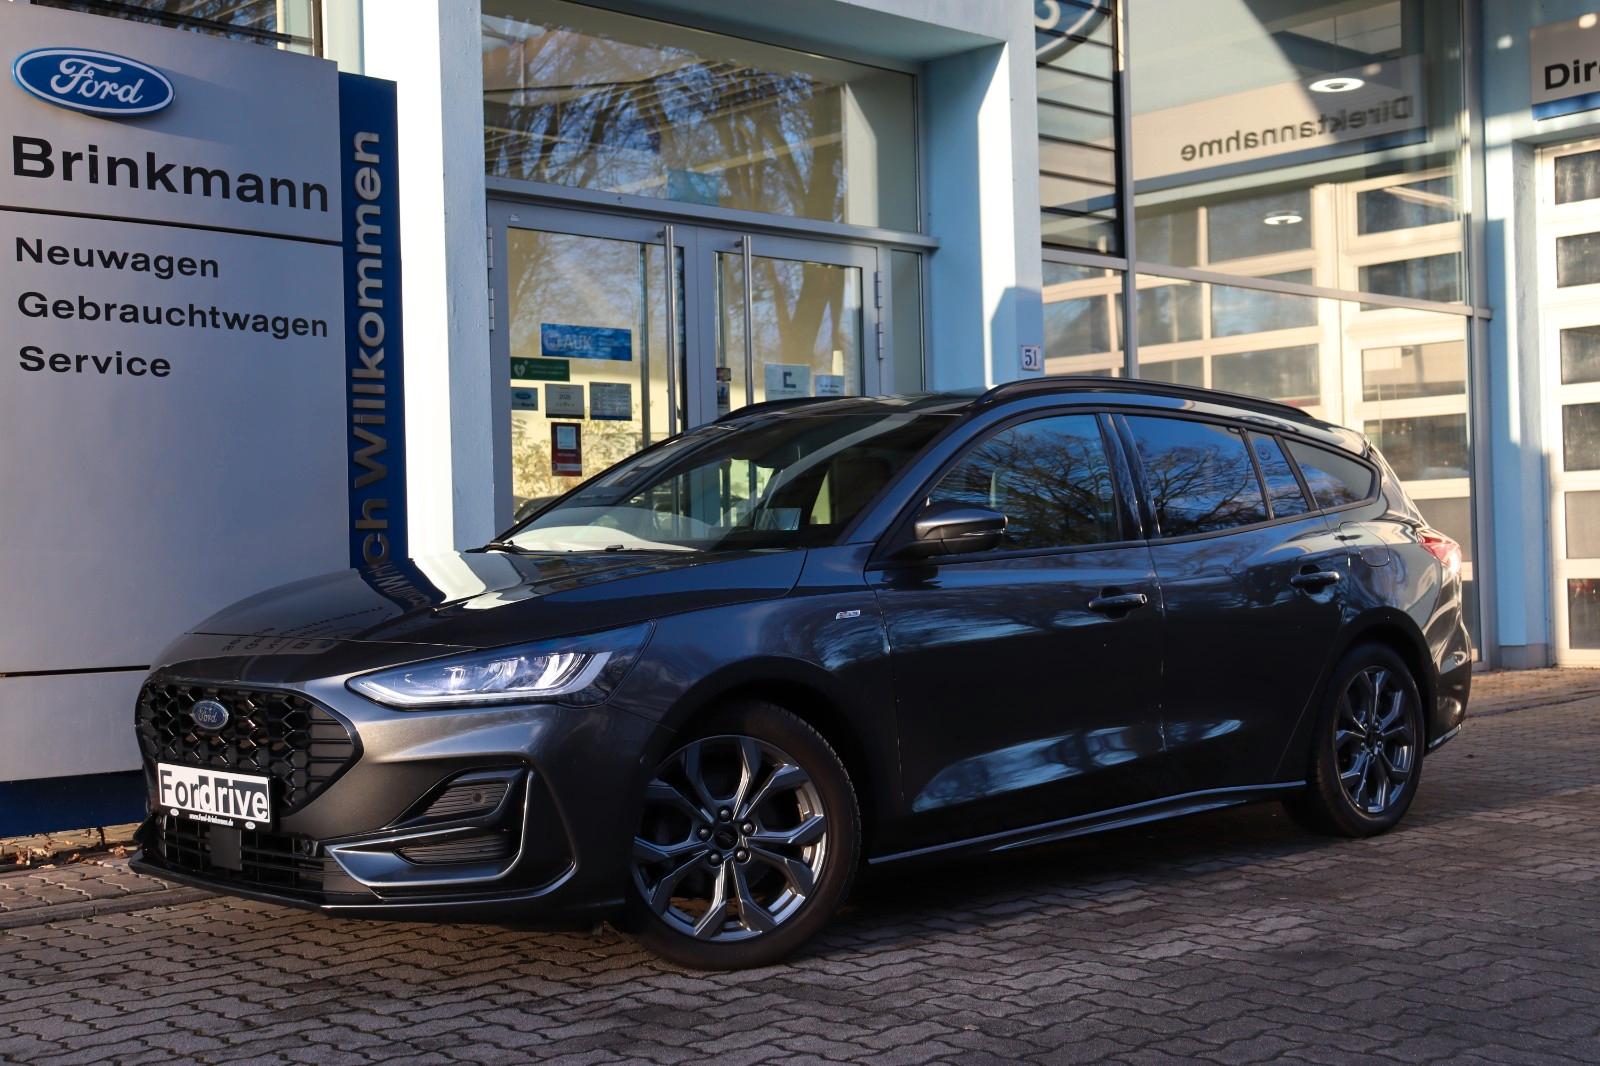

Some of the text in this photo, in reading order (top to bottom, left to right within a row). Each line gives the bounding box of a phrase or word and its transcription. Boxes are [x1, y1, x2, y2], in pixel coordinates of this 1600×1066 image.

[49, 57, 145, 105] Ford
[1544, 59, 1600, 91] Dir
[12, 135, 329, 213] Brinkmann
[15, 237, 219, 280] Neuwagen
[17, 291, 329, 340] Gebrauchtwagen
[352, 131, 388, 488] Willkommen
[19, 345, 171, 378] Service
[1024, 349, 1037, 367] 51
[159, 769, 268, 819] Fordrive
